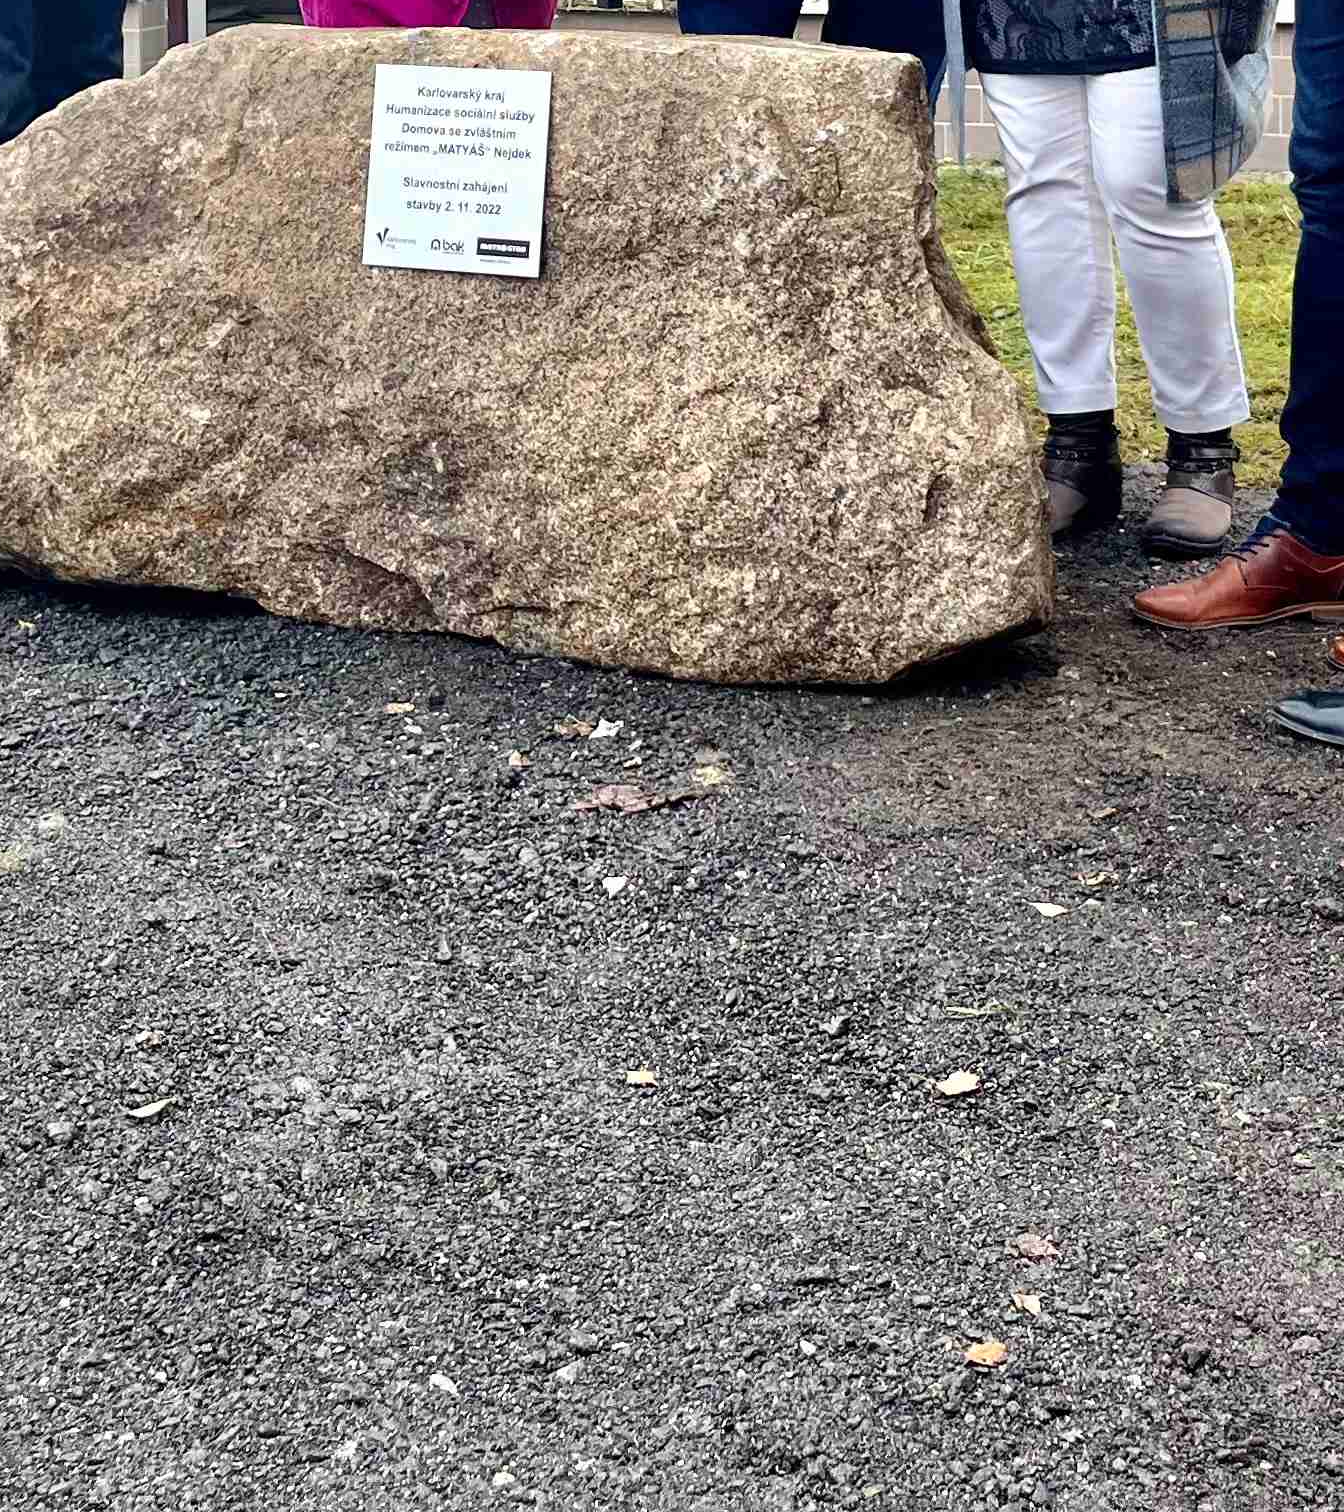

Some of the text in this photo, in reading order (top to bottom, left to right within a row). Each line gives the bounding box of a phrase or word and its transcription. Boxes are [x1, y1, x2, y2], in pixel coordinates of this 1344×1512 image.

[417, 87, 505, 103] Karlovarský kraj
[385, 103, 535, 124] Humanizace sociální služby
[401, 122, 516, 140] Domova se zvláštním
[384, 141, 430, 153] režimem
[494, 146, 532, 161] Nejdek
[403, 176, 508, 195] Slavnostní zahájení
[406, 199, 442, 213] stavby
[476, 203, 502, 215] 2022
